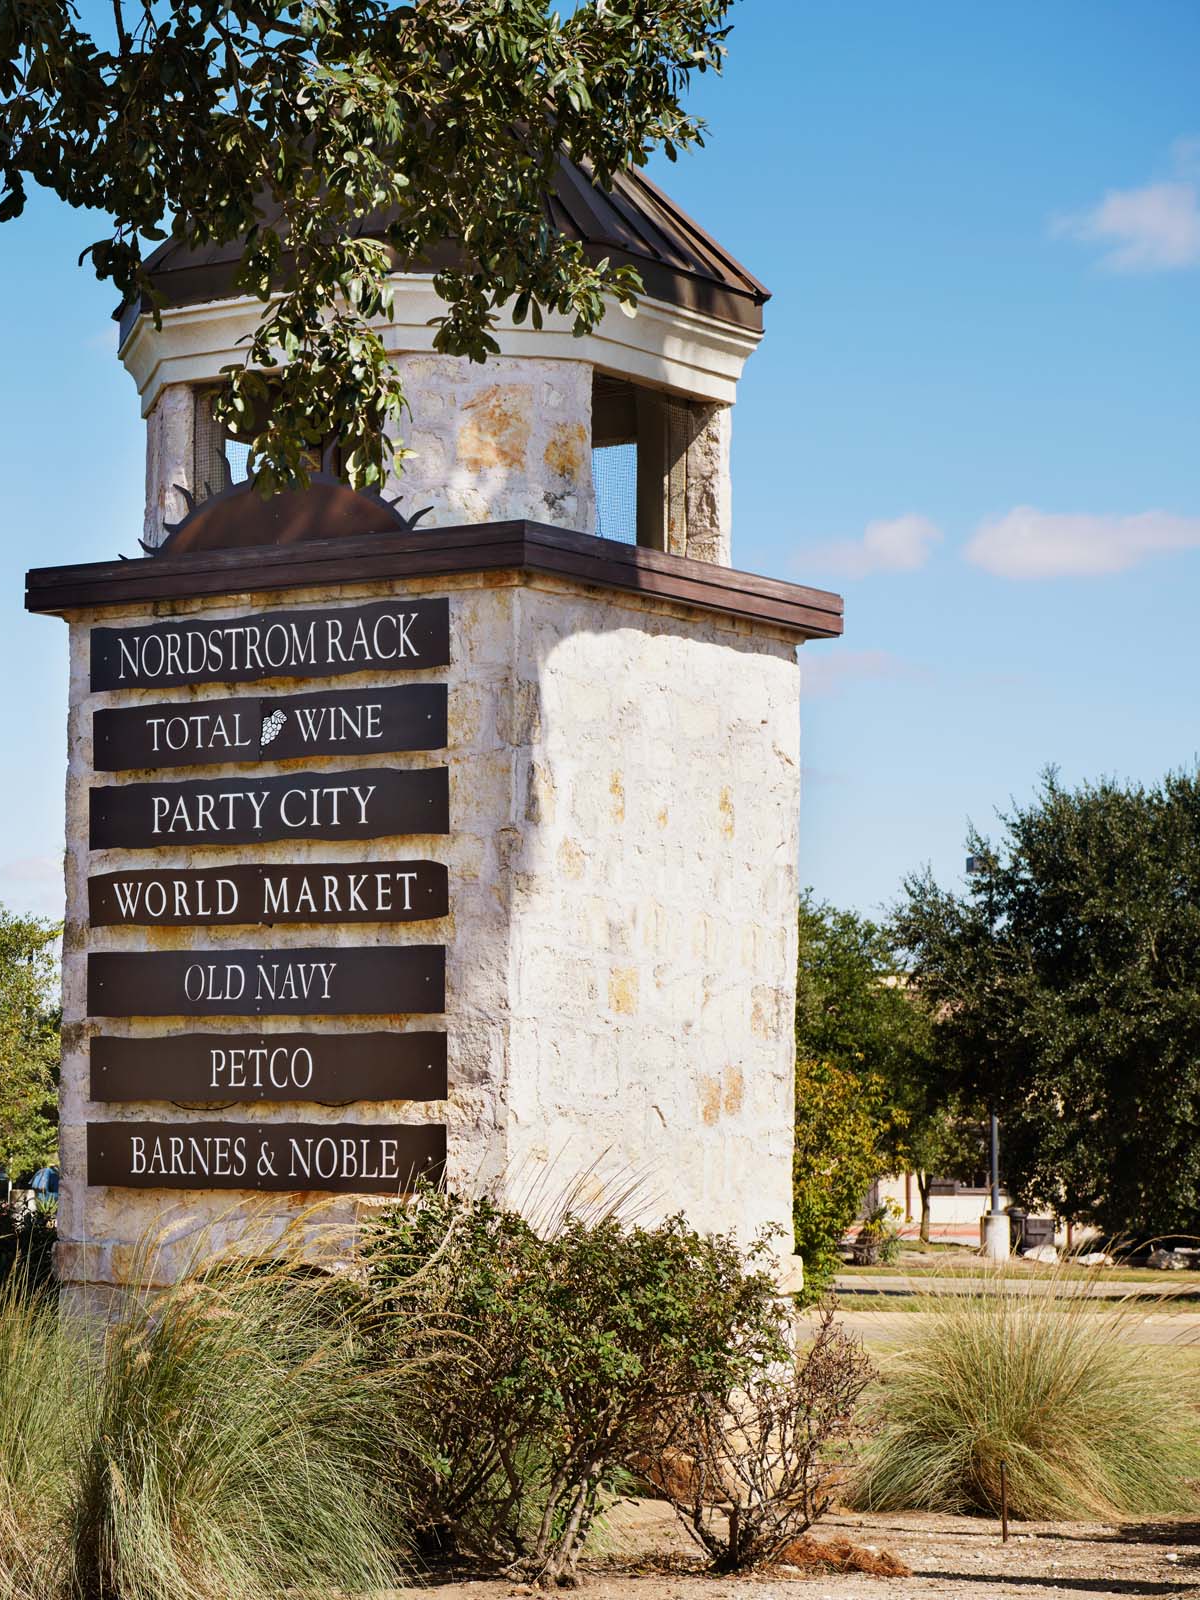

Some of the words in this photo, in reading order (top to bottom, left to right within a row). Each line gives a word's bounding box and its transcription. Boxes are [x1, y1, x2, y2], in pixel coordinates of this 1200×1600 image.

[117, 620, 317, 679] NORDSTROM
[325, 612, 420, 663] RACK
[145, 713, 252, 752] TOTAL
[293, 704, 384, 743] WINE
[151, 791, 271, 834] PARTY
[279, 785, 377, 828] CITY
[112, 879, 239, 918] WORLD
[263, 872, 418, 914] MARKET
[184, 964, 246, 1001] OLD
[254, 962, 337, 1001] NAVY
[209, 1047, 313, 1089] PETCO
[130, 1136, 247, 1177] BARNES
[256, 1141, 279, 1177] &
[288, 1137, 399, 1179] NOBLE
